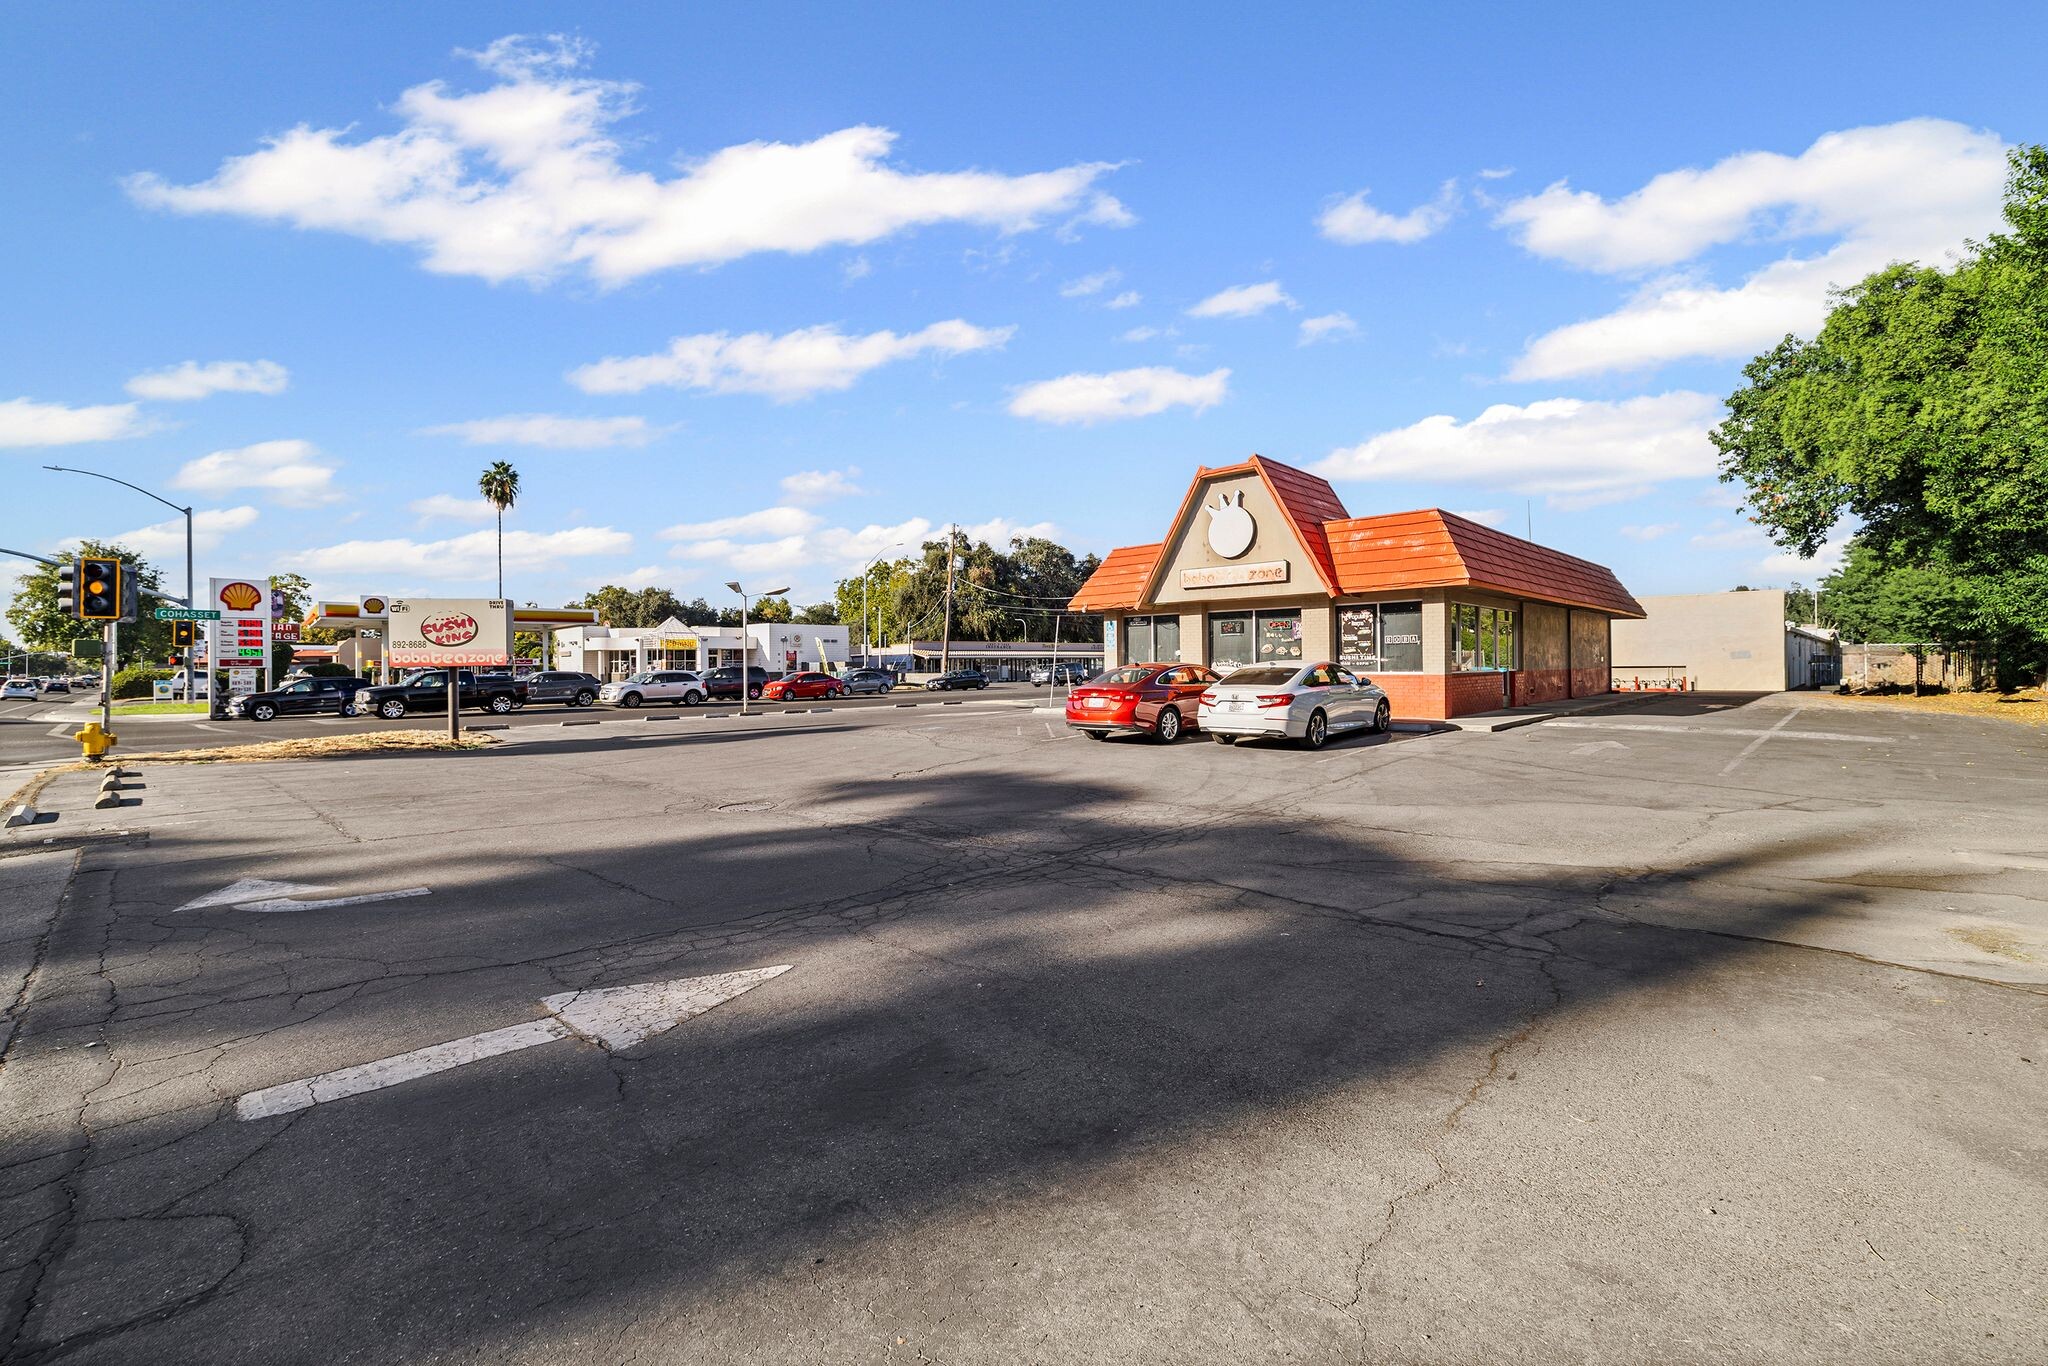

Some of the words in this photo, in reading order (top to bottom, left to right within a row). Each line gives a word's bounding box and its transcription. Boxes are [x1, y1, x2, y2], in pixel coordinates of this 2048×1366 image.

[1248, 568, 1283, 581] zone
[160, 610, 217, 619] COHASSET
[422, 617, 474, 635] SUSHI
[1269, 621, 1288, 629] OPEN
[435, 631, 473, 645] KING
[1385, 635, 1418, 644] BOBA
[392, 640, 427, 649] 892-8688
